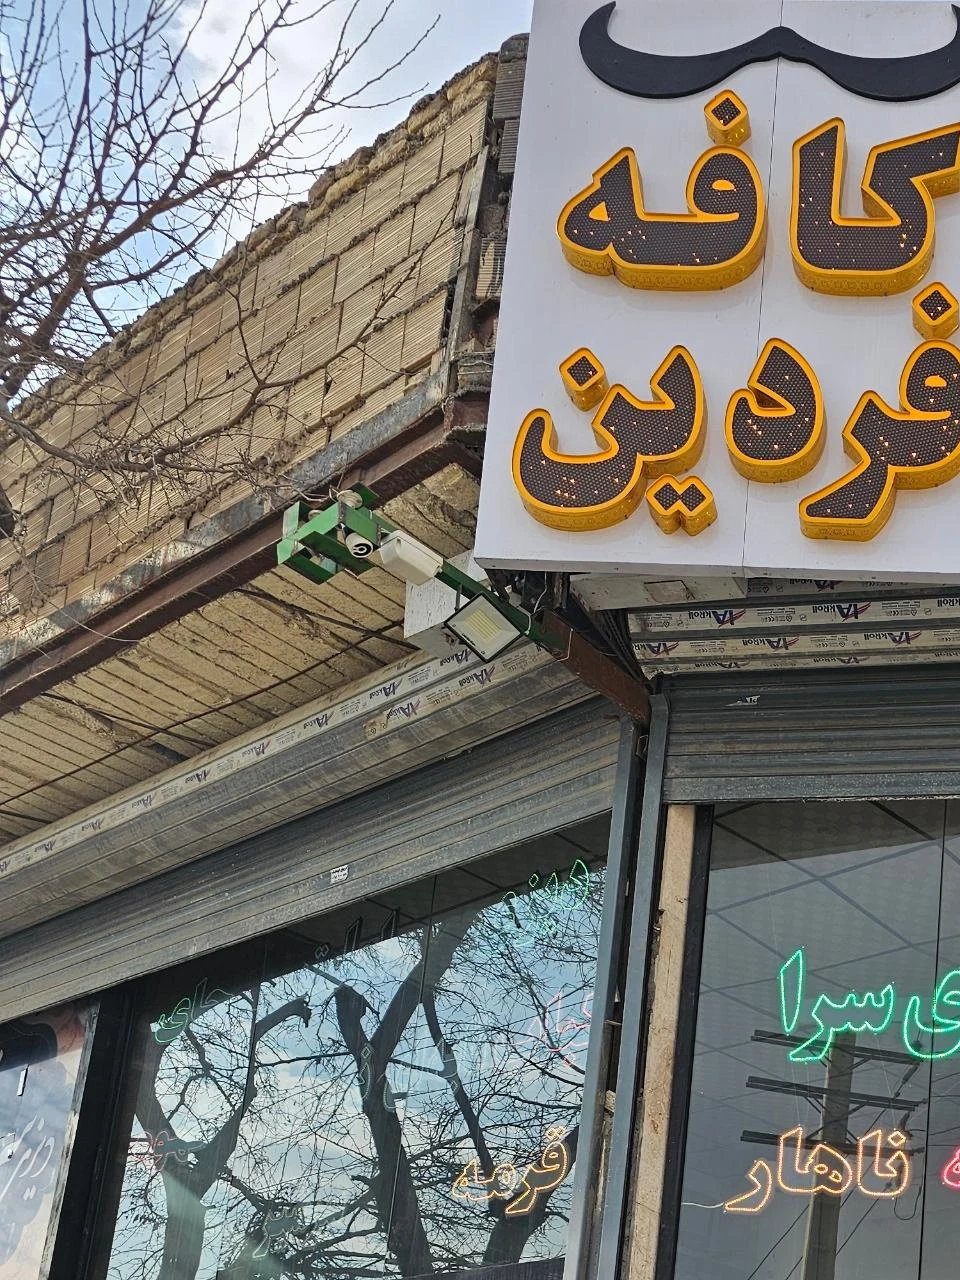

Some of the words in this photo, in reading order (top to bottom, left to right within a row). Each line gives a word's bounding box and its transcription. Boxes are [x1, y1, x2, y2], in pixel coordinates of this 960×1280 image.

[777, 946, 895, 1062] سرا
[452, 1126, 568, 1217] قرمه
[724, 1124, 913, 1214] ناهار
